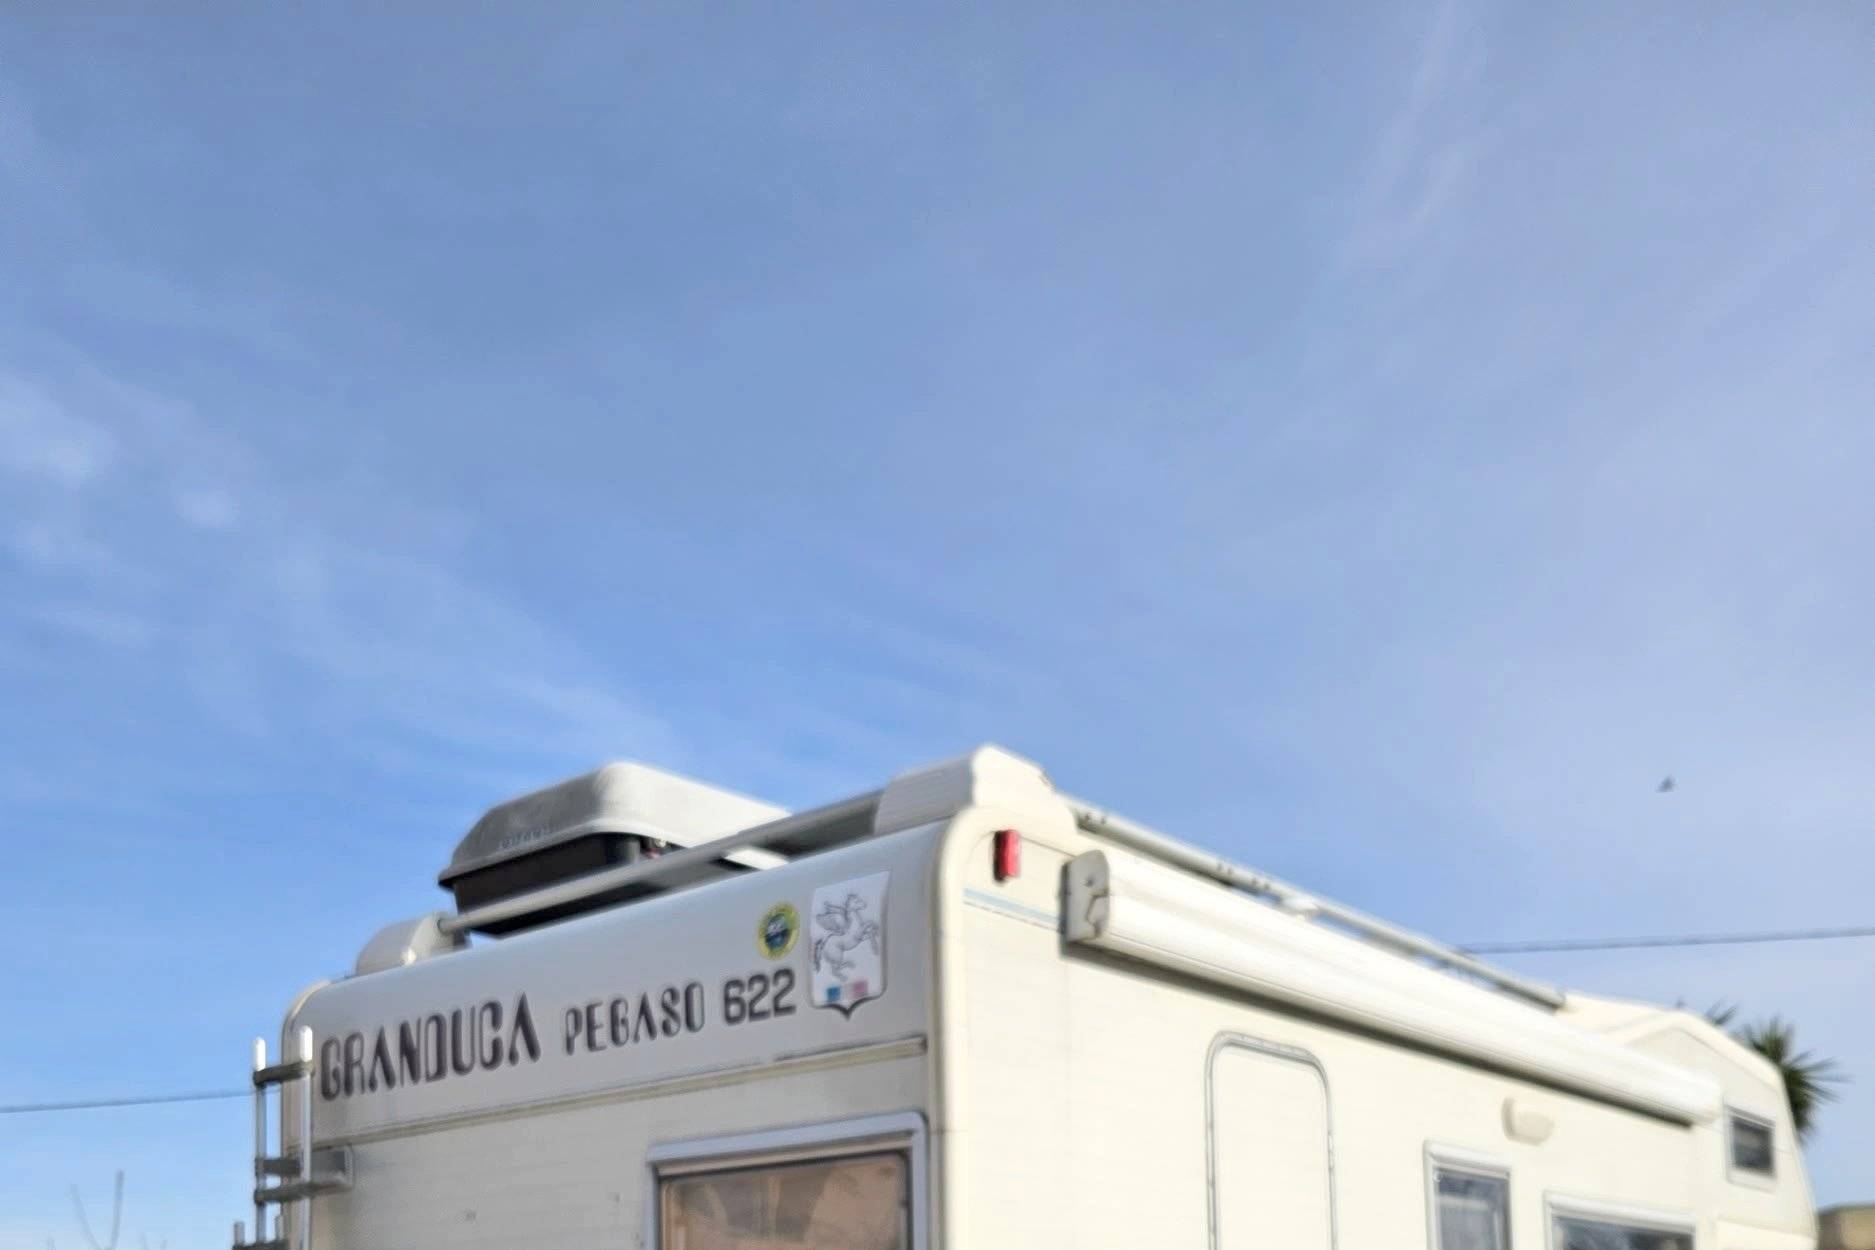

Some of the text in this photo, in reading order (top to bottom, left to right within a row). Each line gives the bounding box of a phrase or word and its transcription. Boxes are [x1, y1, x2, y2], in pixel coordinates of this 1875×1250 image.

[320, 967, 797, 1101] GRANDUCA PEGASO 622
